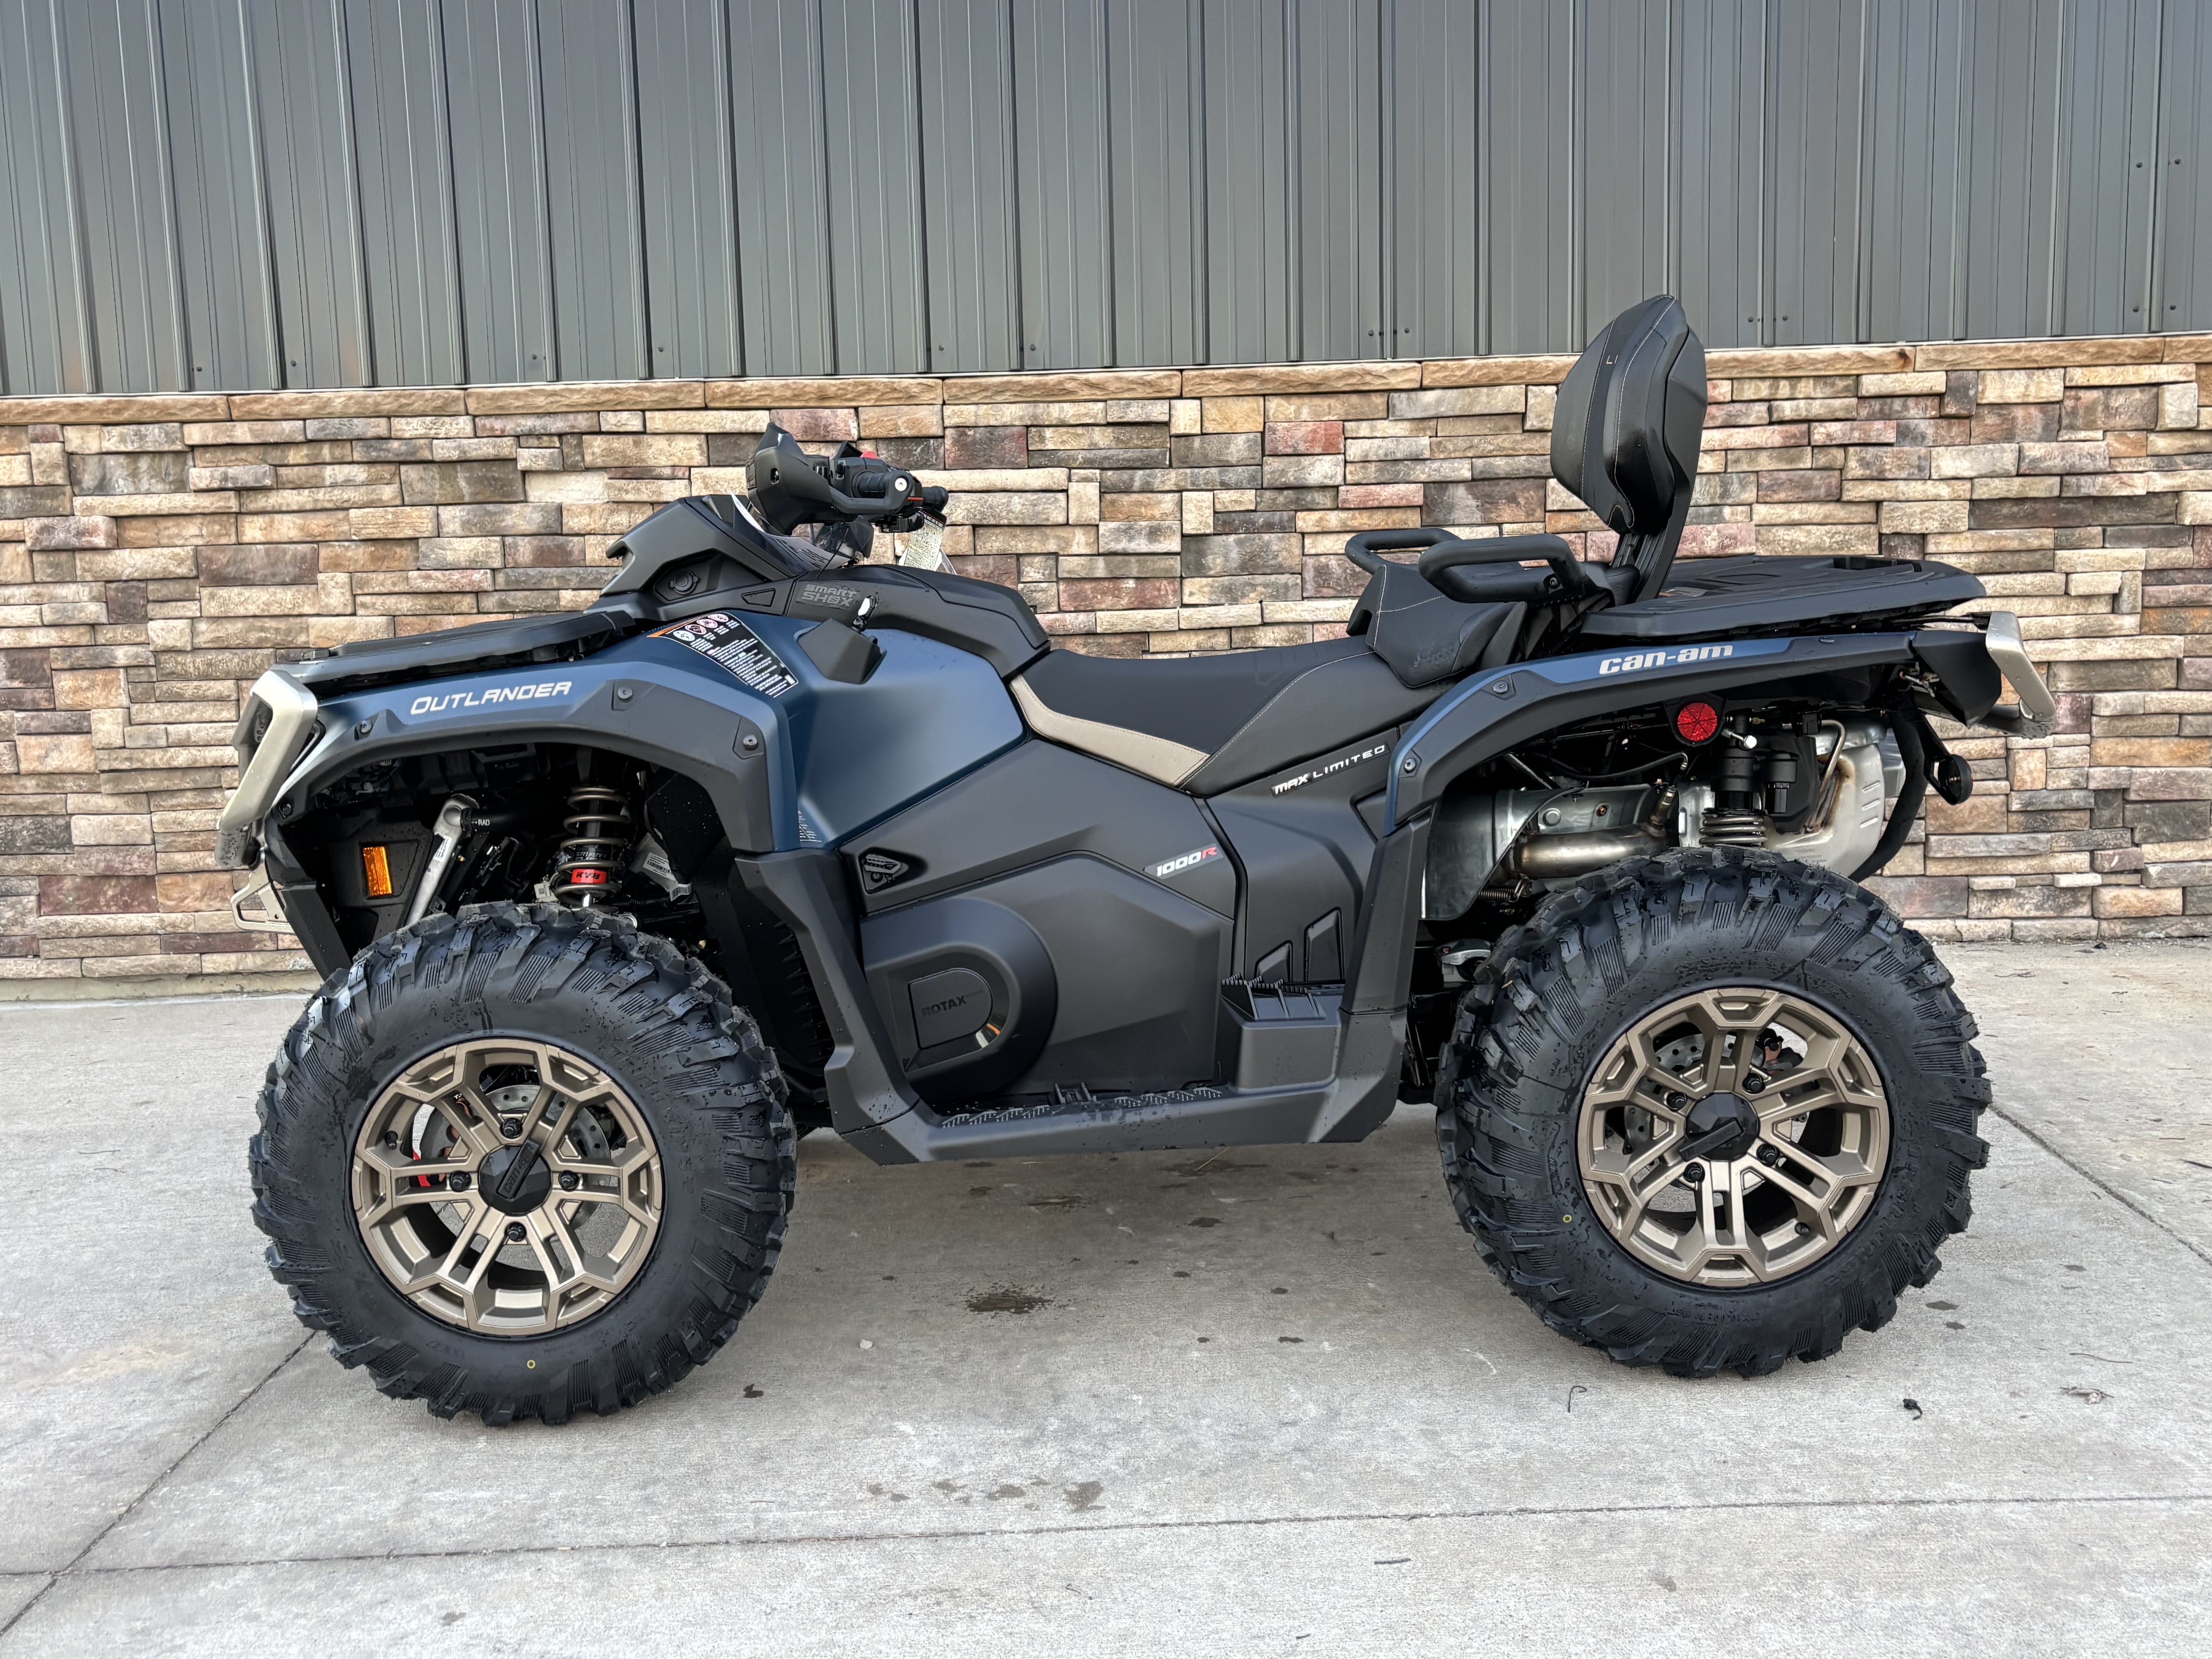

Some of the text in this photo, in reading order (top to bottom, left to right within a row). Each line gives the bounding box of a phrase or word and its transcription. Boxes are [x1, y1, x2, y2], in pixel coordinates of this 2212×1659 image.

[804, 584, 857, 598] SMART
[1599, 645, 1733, 675] can-am
[410, 681, 572, 715] OUTLANDER
[1272, 744, 1386, 795] MAX LIMITED
[1157, 847, 1218, 877] 1000R
[921, 994, 968, 1018] ROTAX
